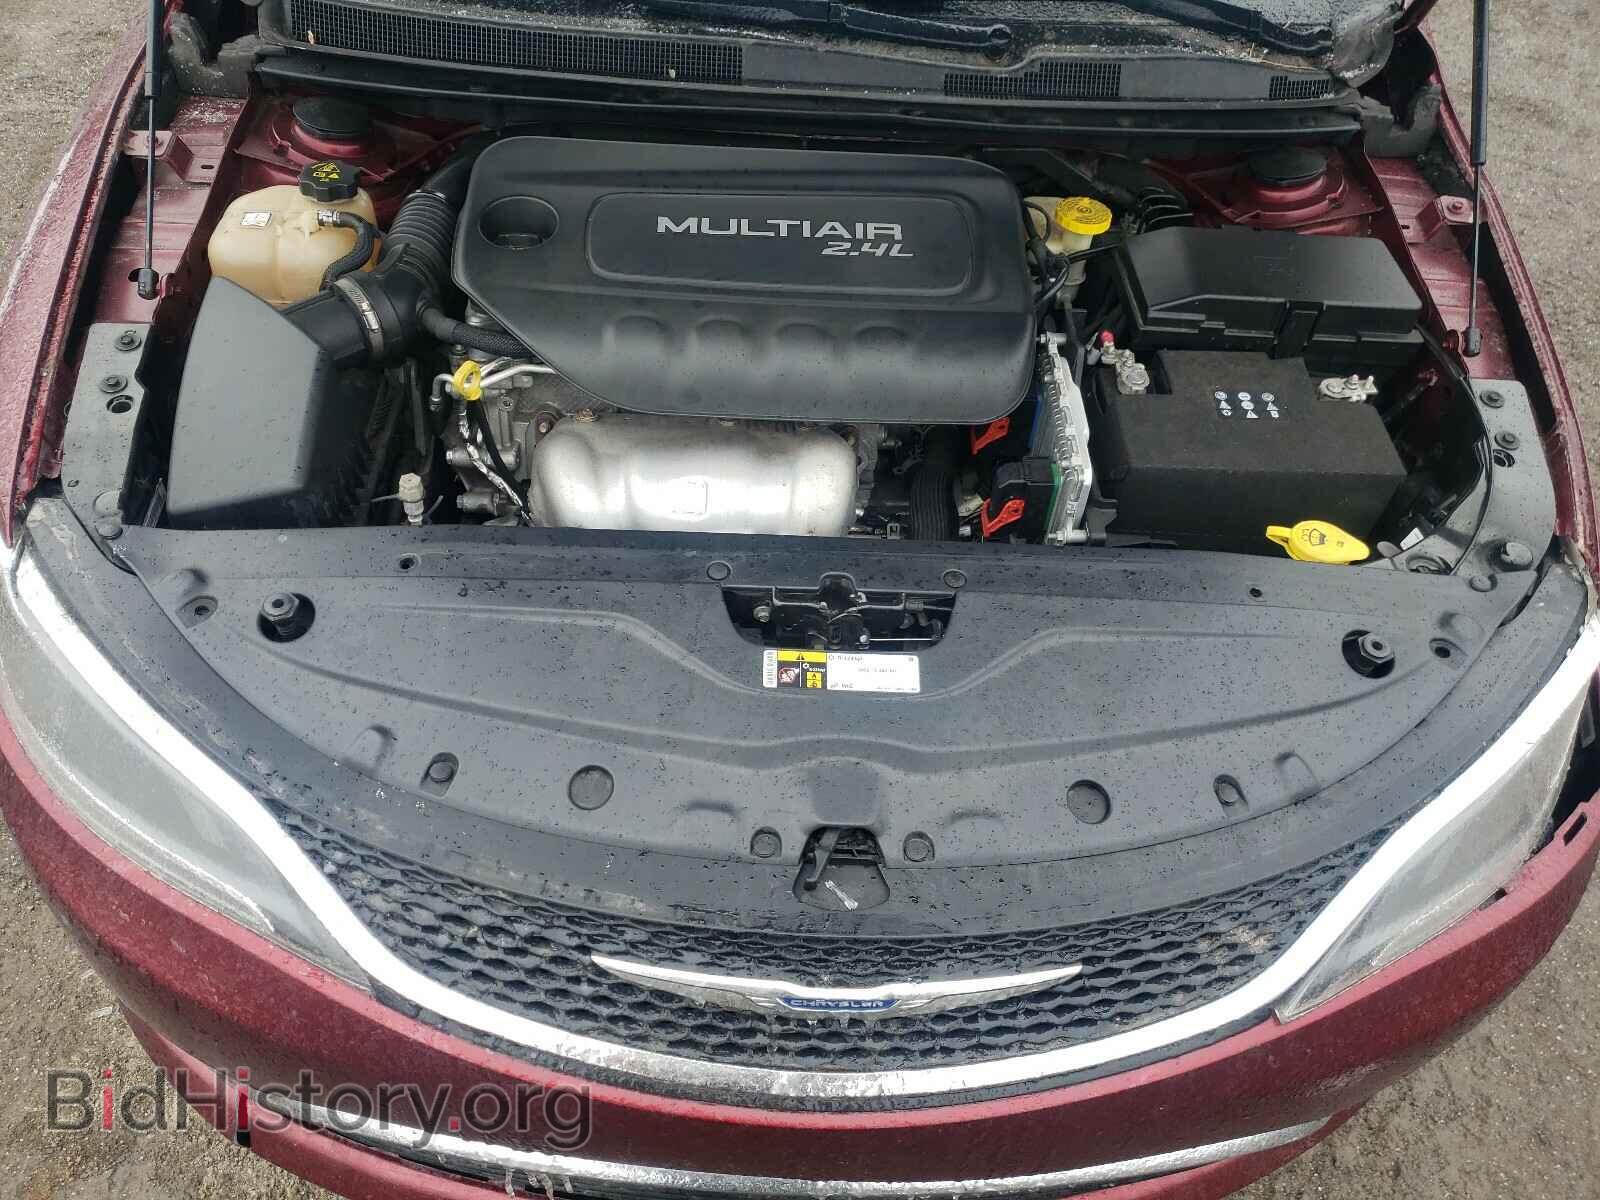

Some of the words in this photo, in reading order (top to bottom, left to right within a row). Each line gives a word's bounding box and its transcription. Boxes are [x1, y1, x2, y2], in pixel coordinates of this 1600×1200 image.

[656, 216, 903, 240] MULTIAIR
[821, 241, 914, 257] 2.4L
[789, 999, 884, 1008] CHRYSLER
